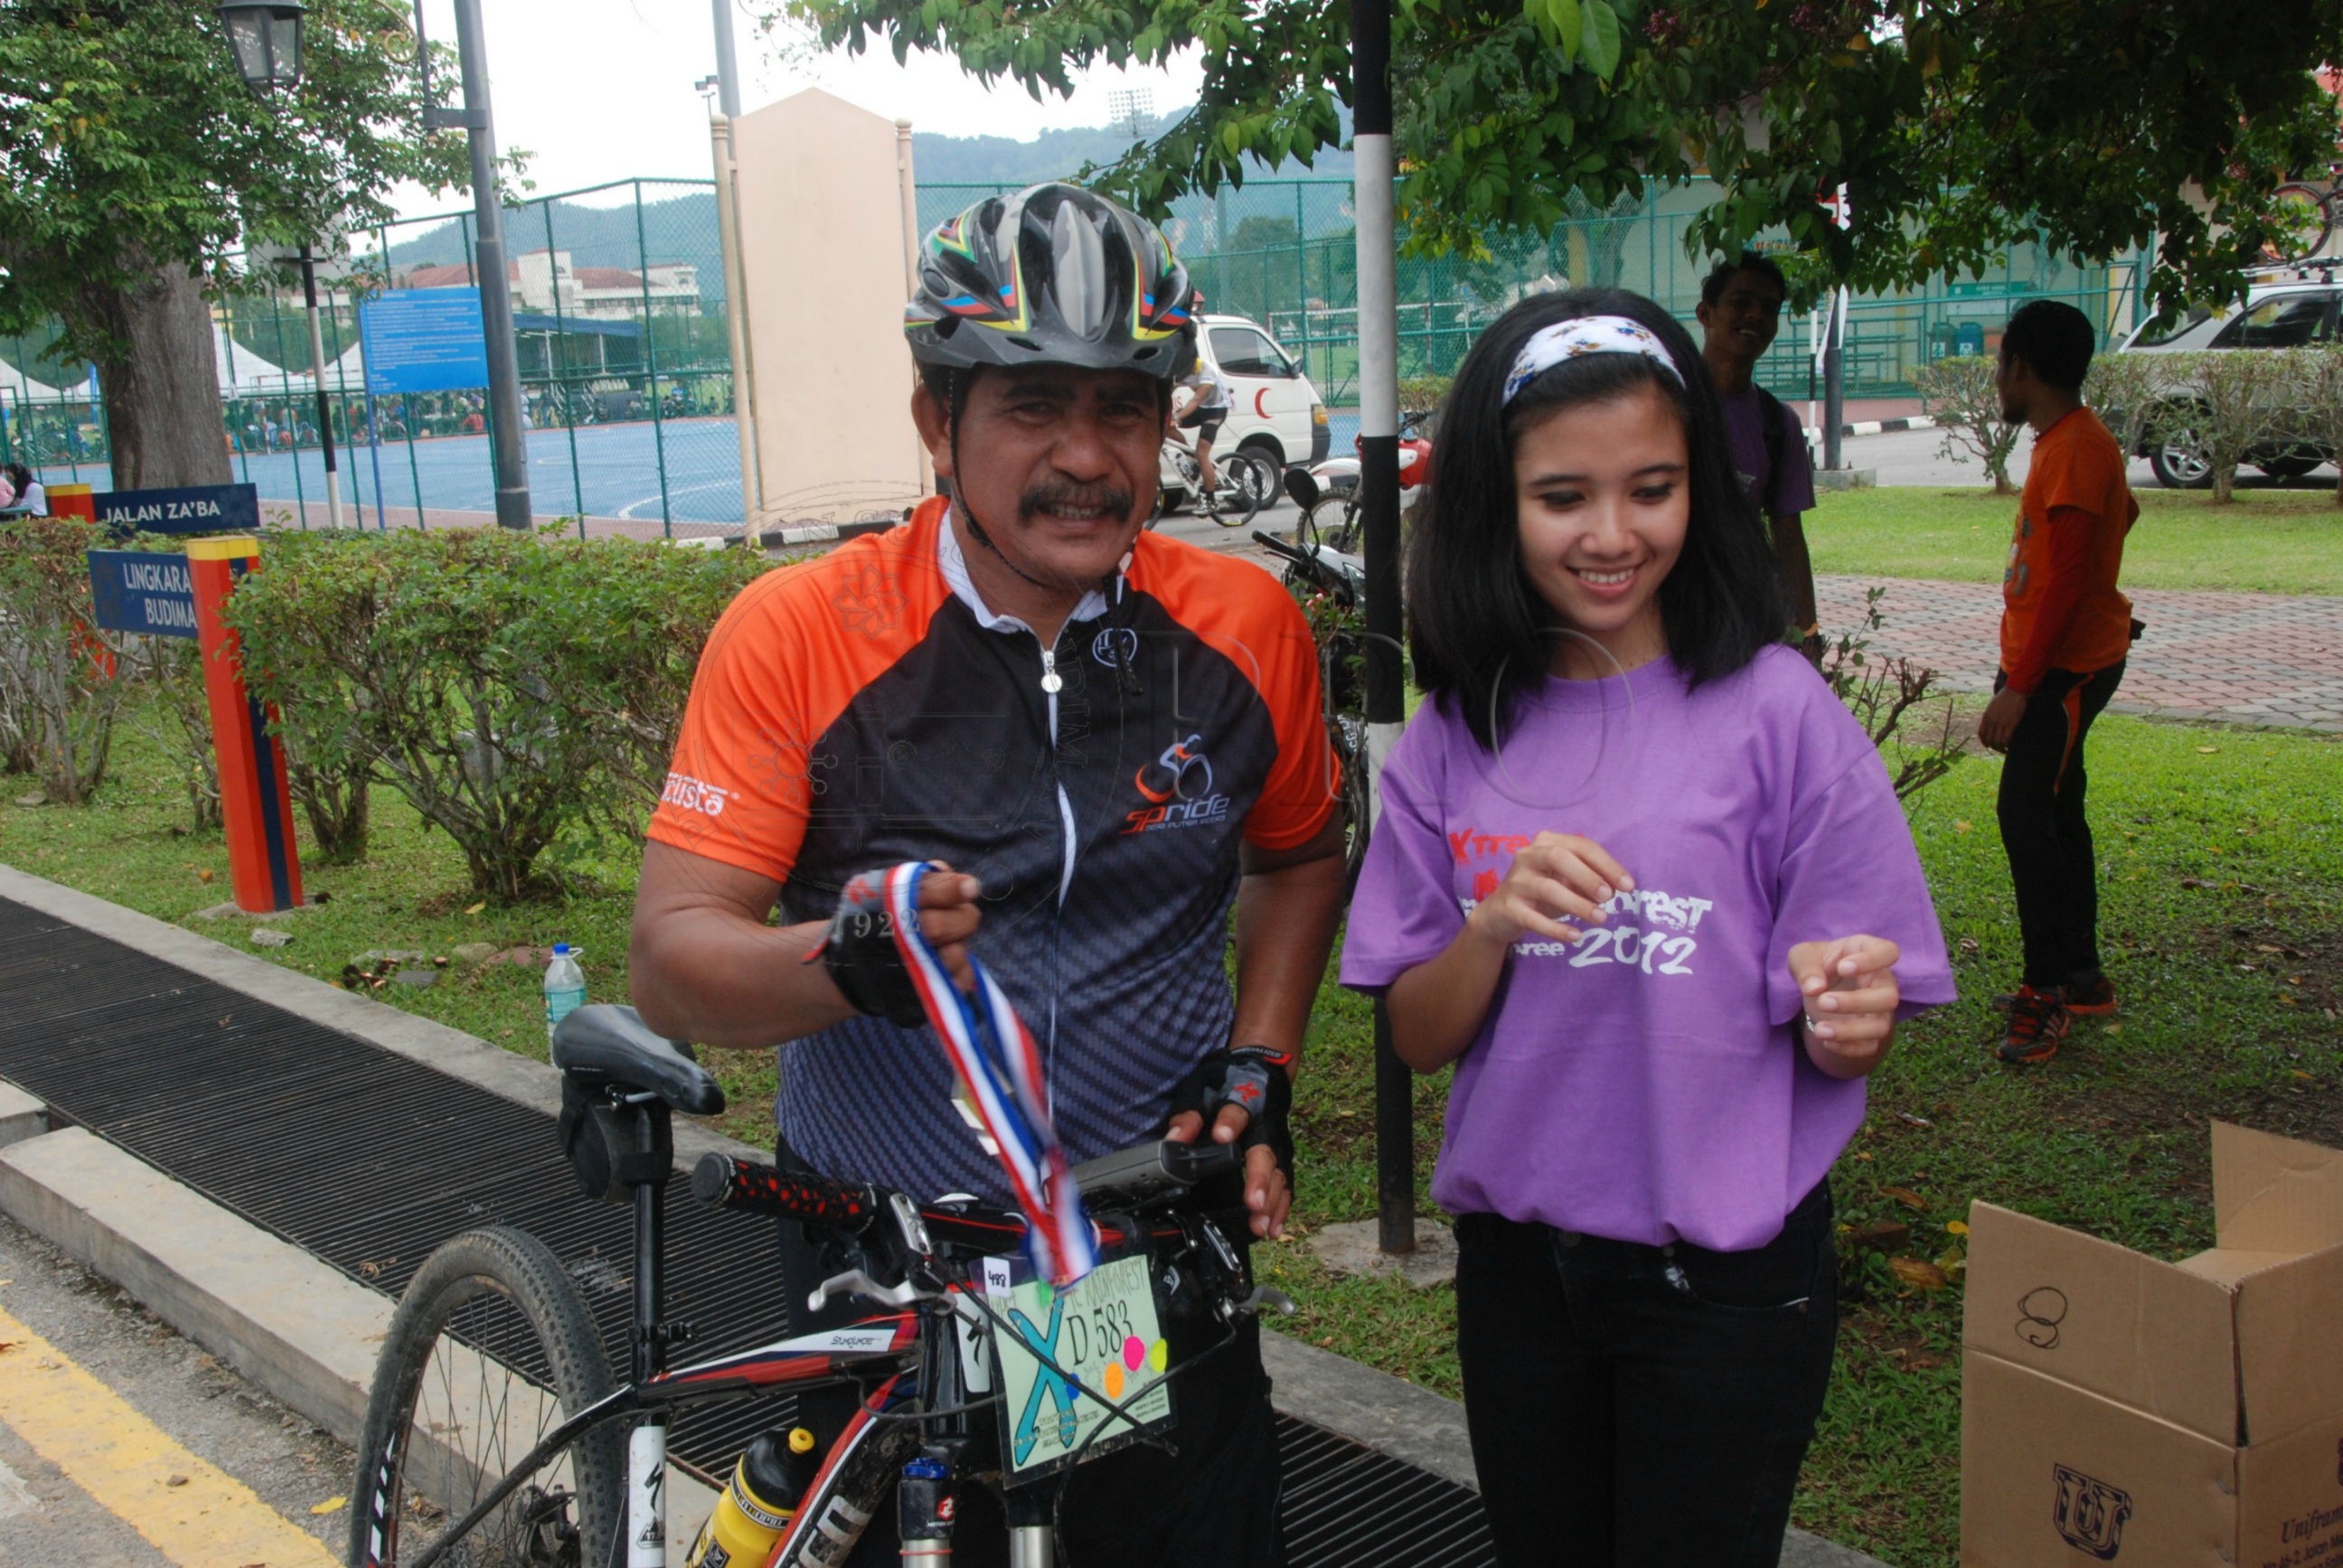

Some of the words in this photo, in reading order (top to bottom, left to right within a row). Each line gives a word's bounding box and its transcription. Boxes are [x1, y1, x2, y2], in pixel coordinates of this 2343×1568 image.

[106, 502, 162, 524] JALAN
[167, 500, 221, 520] ZA'BA
[123, 562, 194, 594] LINGKARA
[145, 597, 199, 628] BUDIMA
[1568, 925, 1697, 975] 2012
[1067, 1314, 1088, 1366] D
[1093, 1300, 1134, 1358] 583
